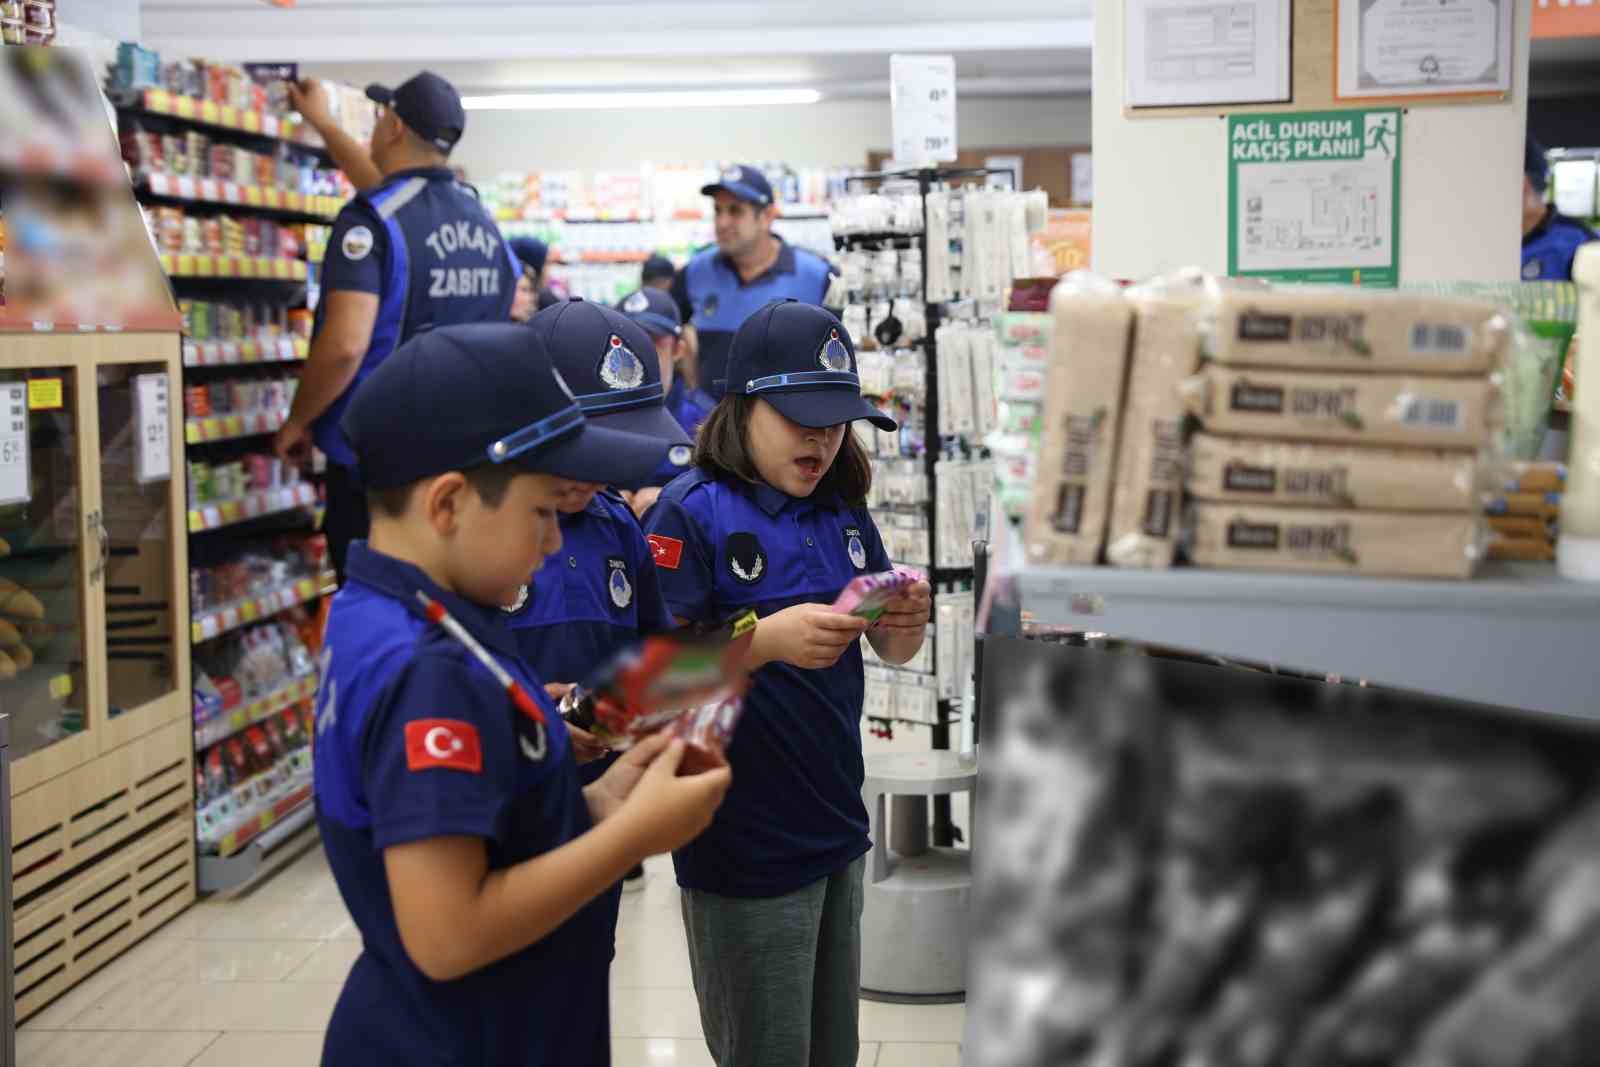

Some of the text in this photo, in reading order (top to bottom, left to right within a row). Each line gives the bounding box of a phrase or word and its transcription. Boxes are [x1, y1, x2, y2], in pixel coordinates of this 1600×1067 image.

[1232, 119, 1352, 141] ACİL DURUM
[1233, 141, 1290, 161] KAÇIŞ
[425, 220, 499, 260] TOKAT
[429, 267, 500, 298] ZABITA
